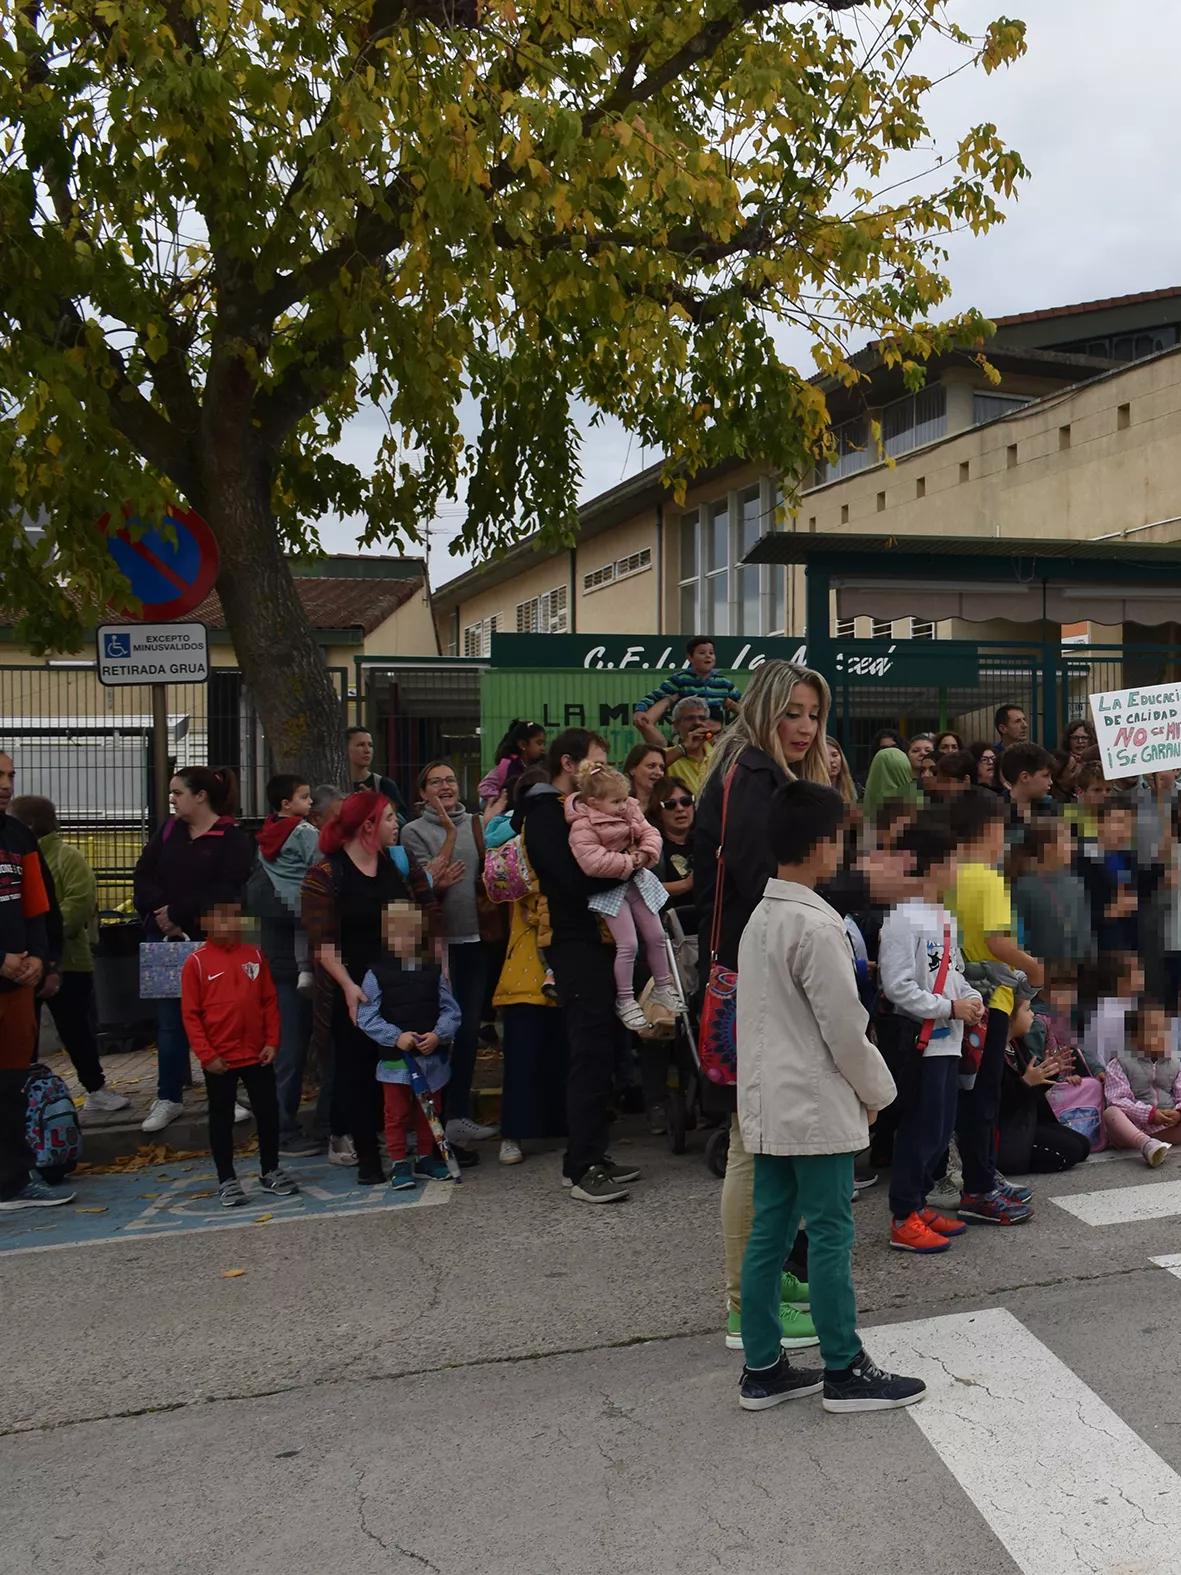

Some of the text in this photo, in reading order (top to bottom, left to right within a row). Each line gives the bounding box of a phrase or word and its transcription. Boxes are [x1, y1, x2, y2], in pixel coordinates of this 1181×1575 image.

[146, 634, 190, 643] EXCEPTO
[133, 642, 204, 652] MINUSVALIDOS
[102, 663, 206, 676] RETIRADA GRUA
[543, 704, 586, 726] LA
[1104, 708, 1178, 726] DE CALIDAD
[1113, 726, 1148, 748] NO
